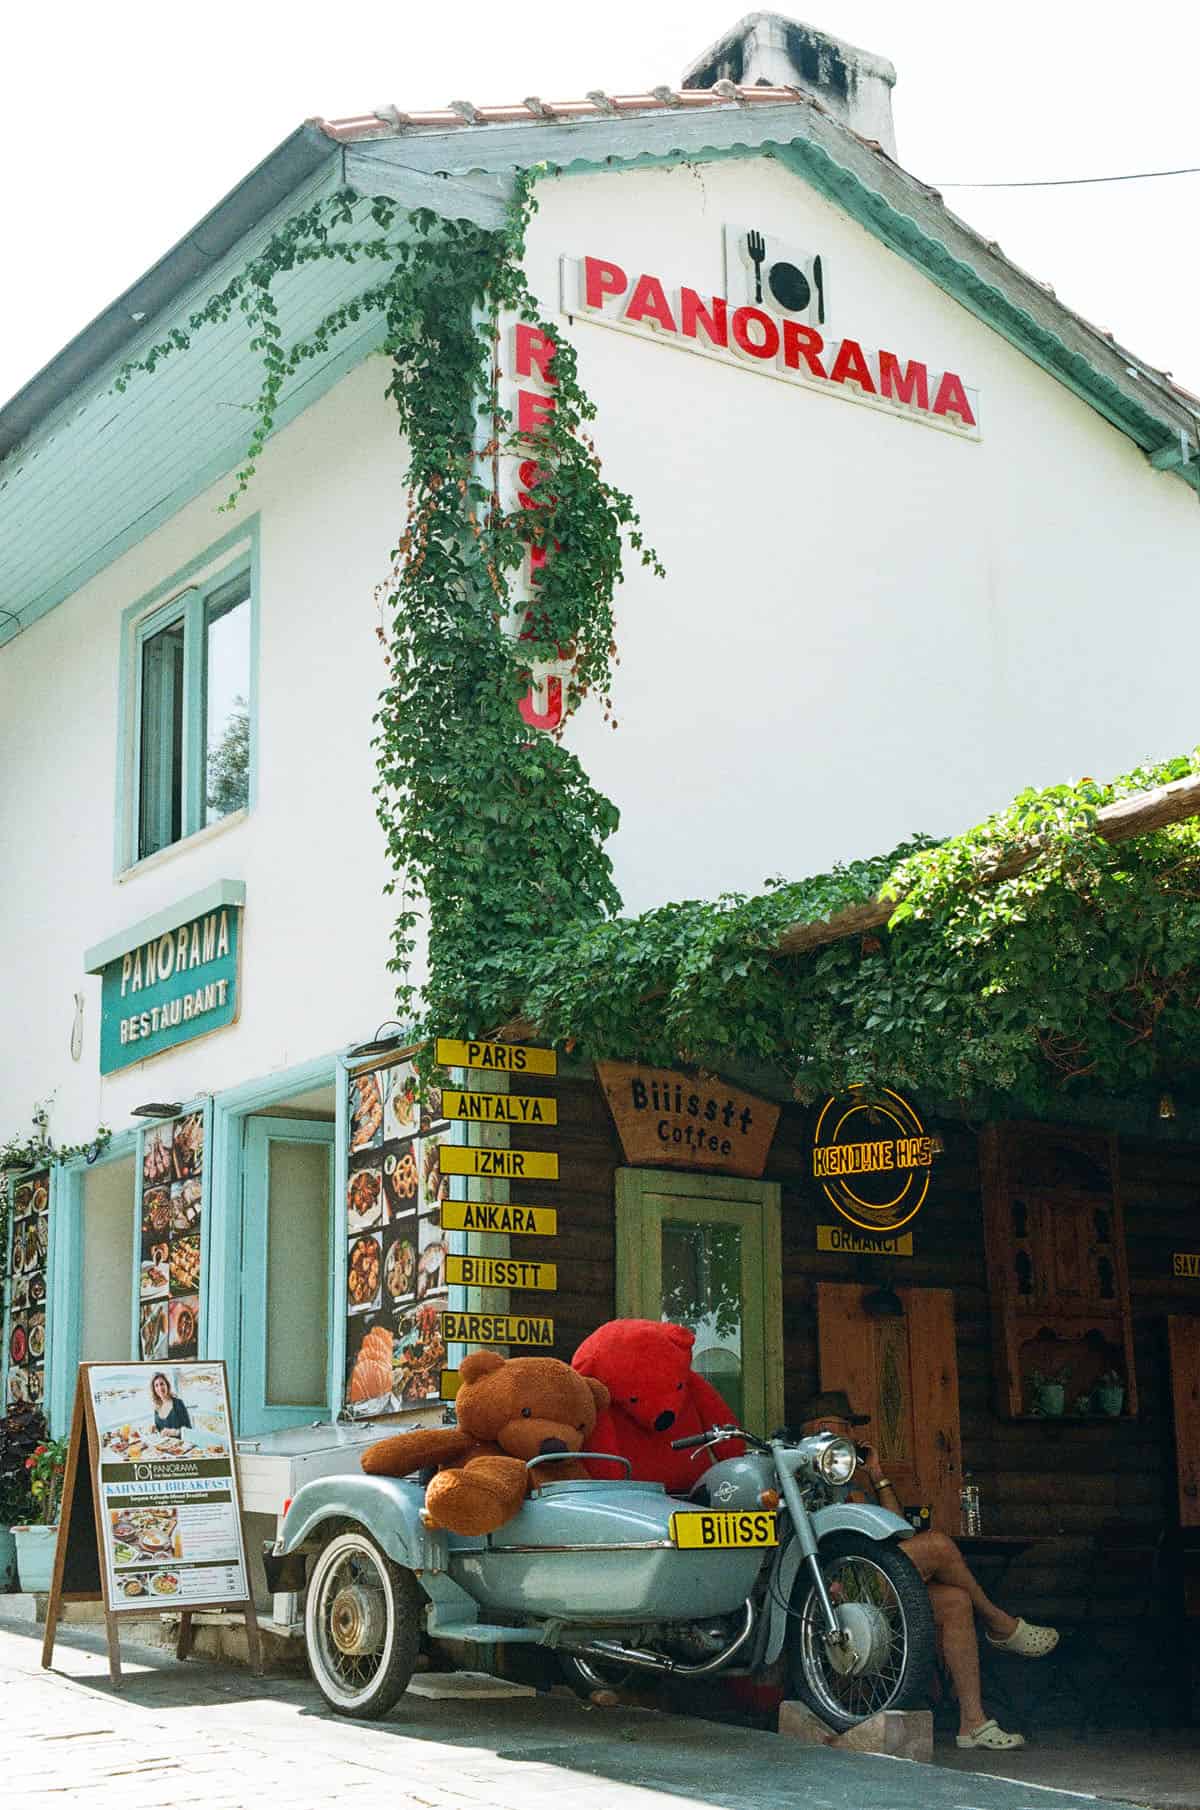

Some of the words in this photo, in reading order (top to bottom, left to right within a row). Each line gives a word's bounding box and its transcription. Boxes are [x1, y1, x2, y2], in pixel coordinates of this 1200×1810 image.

[584, 256, 977, 427] PANORAMA
[120, 910, 229, 997] PANORAMA
[120, 979, 228, 1044] RESTAURANT
[458, 1095, 543, 1121] ANTALYA
[658, 1119, 733, 1155] Coffee
[896, 1137, 933, 1168] HAS
[463, 1205, 537, 1232] ANKARA
[444, 1315, 552, 1344] BARSELONA
[153, 1463, 198, 1473] PANORAMA
[165, 1478, 230, 1491] BREAKFAST
